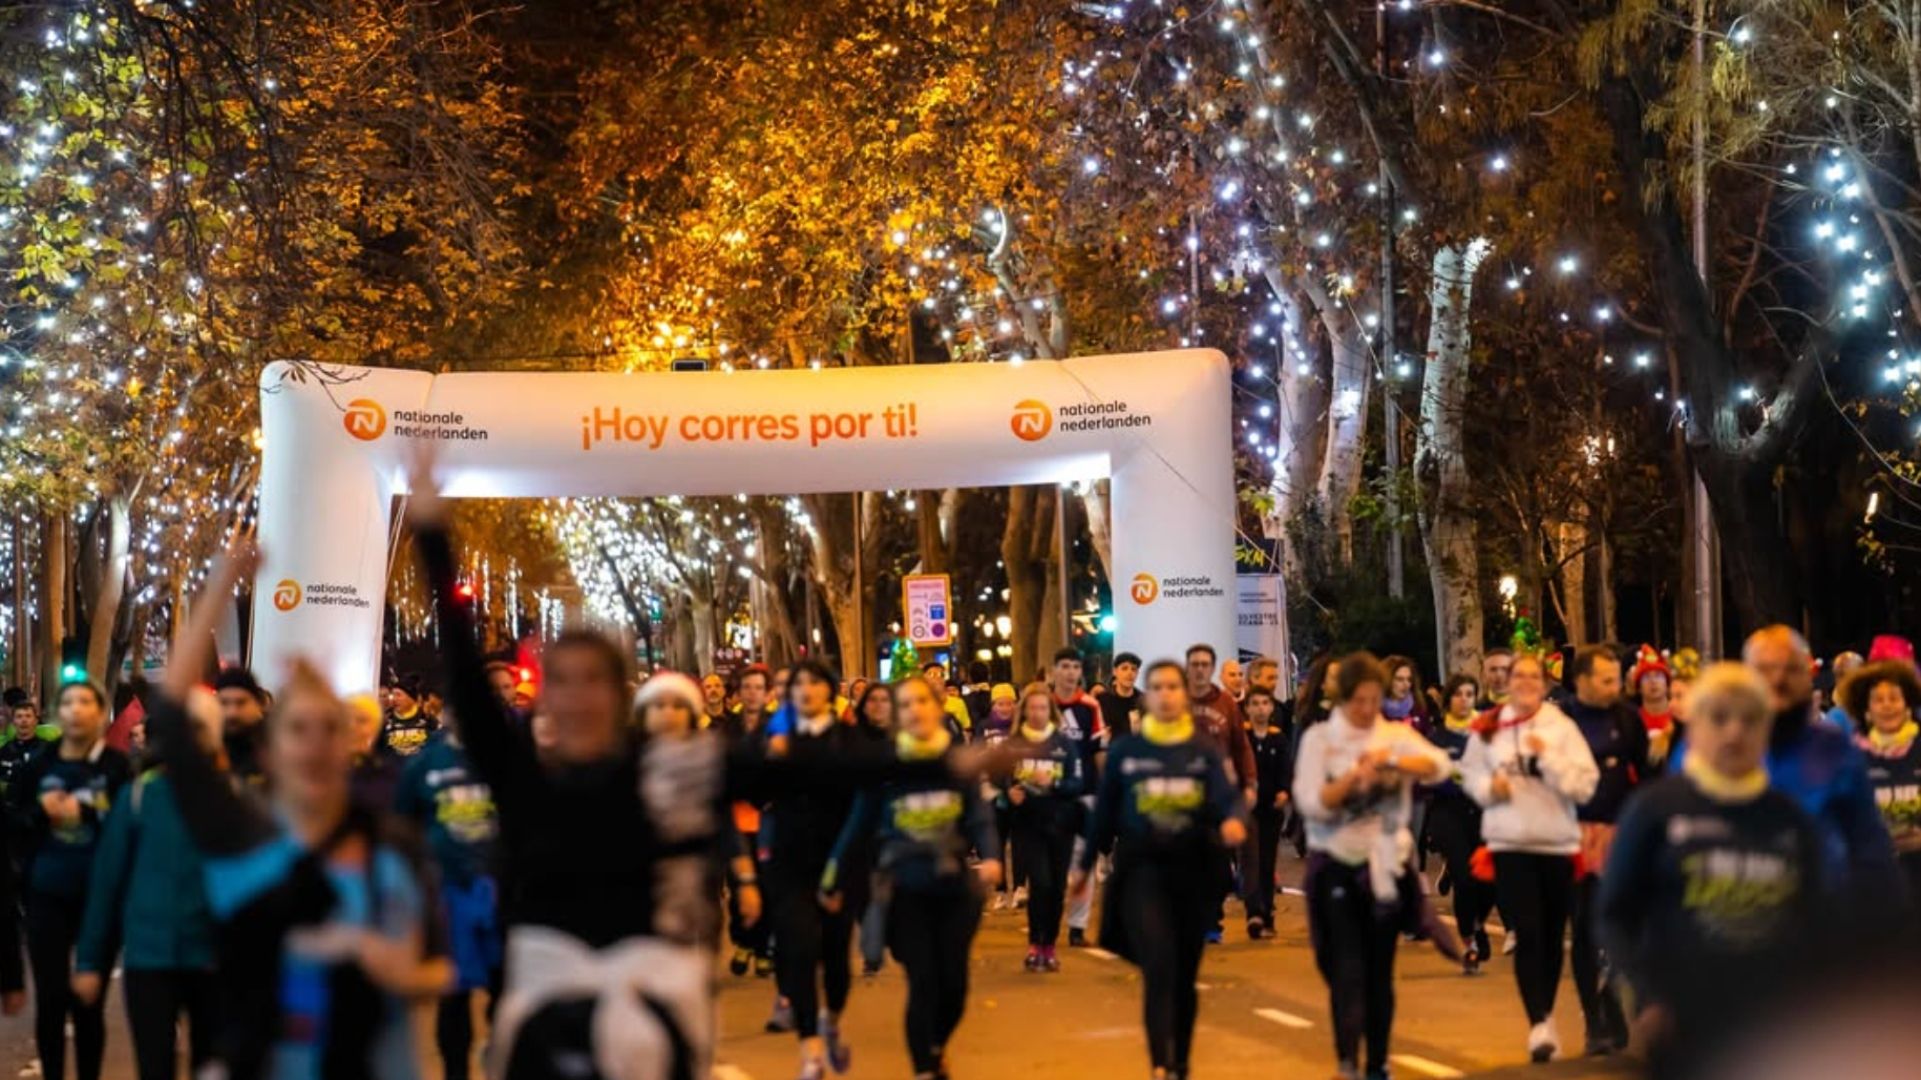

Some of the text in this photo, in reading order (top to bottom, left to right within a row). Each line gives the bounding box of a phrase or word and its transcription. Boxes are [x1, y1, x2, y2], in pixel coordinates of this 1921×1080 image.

[1059, 400, 1127, 416] nationale
[394, 410, 463, 425] nationale
[1060, 414, 1152, 431] nederlanden
[394, 424, 488, 440] nederlanden
[582, 402, 918, 450] ¡Hoy corres por ti!
[1163, 576, 1211, 587] nationale
[306, 584, 357, 595] nationale
[1163, 587, 1224, 598] nederlanden
[306, 595, 370, 608] nederlanden
